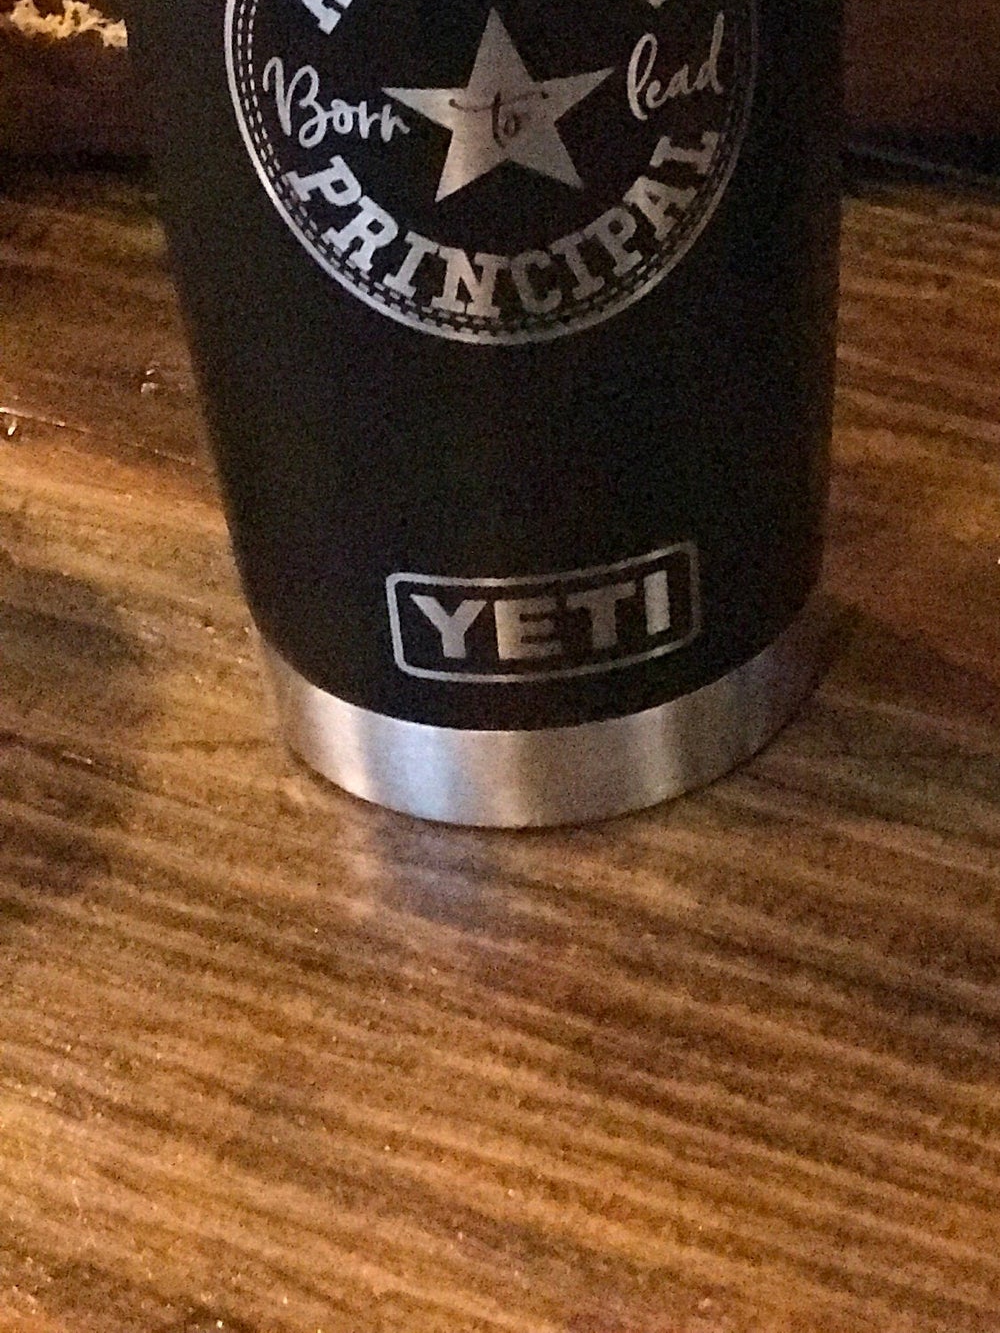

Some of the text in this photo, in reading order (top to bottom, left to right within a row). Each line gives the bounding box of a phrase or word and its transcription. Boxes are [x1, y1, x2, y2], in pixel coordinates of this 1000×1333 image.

[262, 57, 411, 148] Born
[627, 12, 725, 121] lead
[285, 132, 725, 317] PRINCIPAL
[410, 569, 671, 660] YETI
